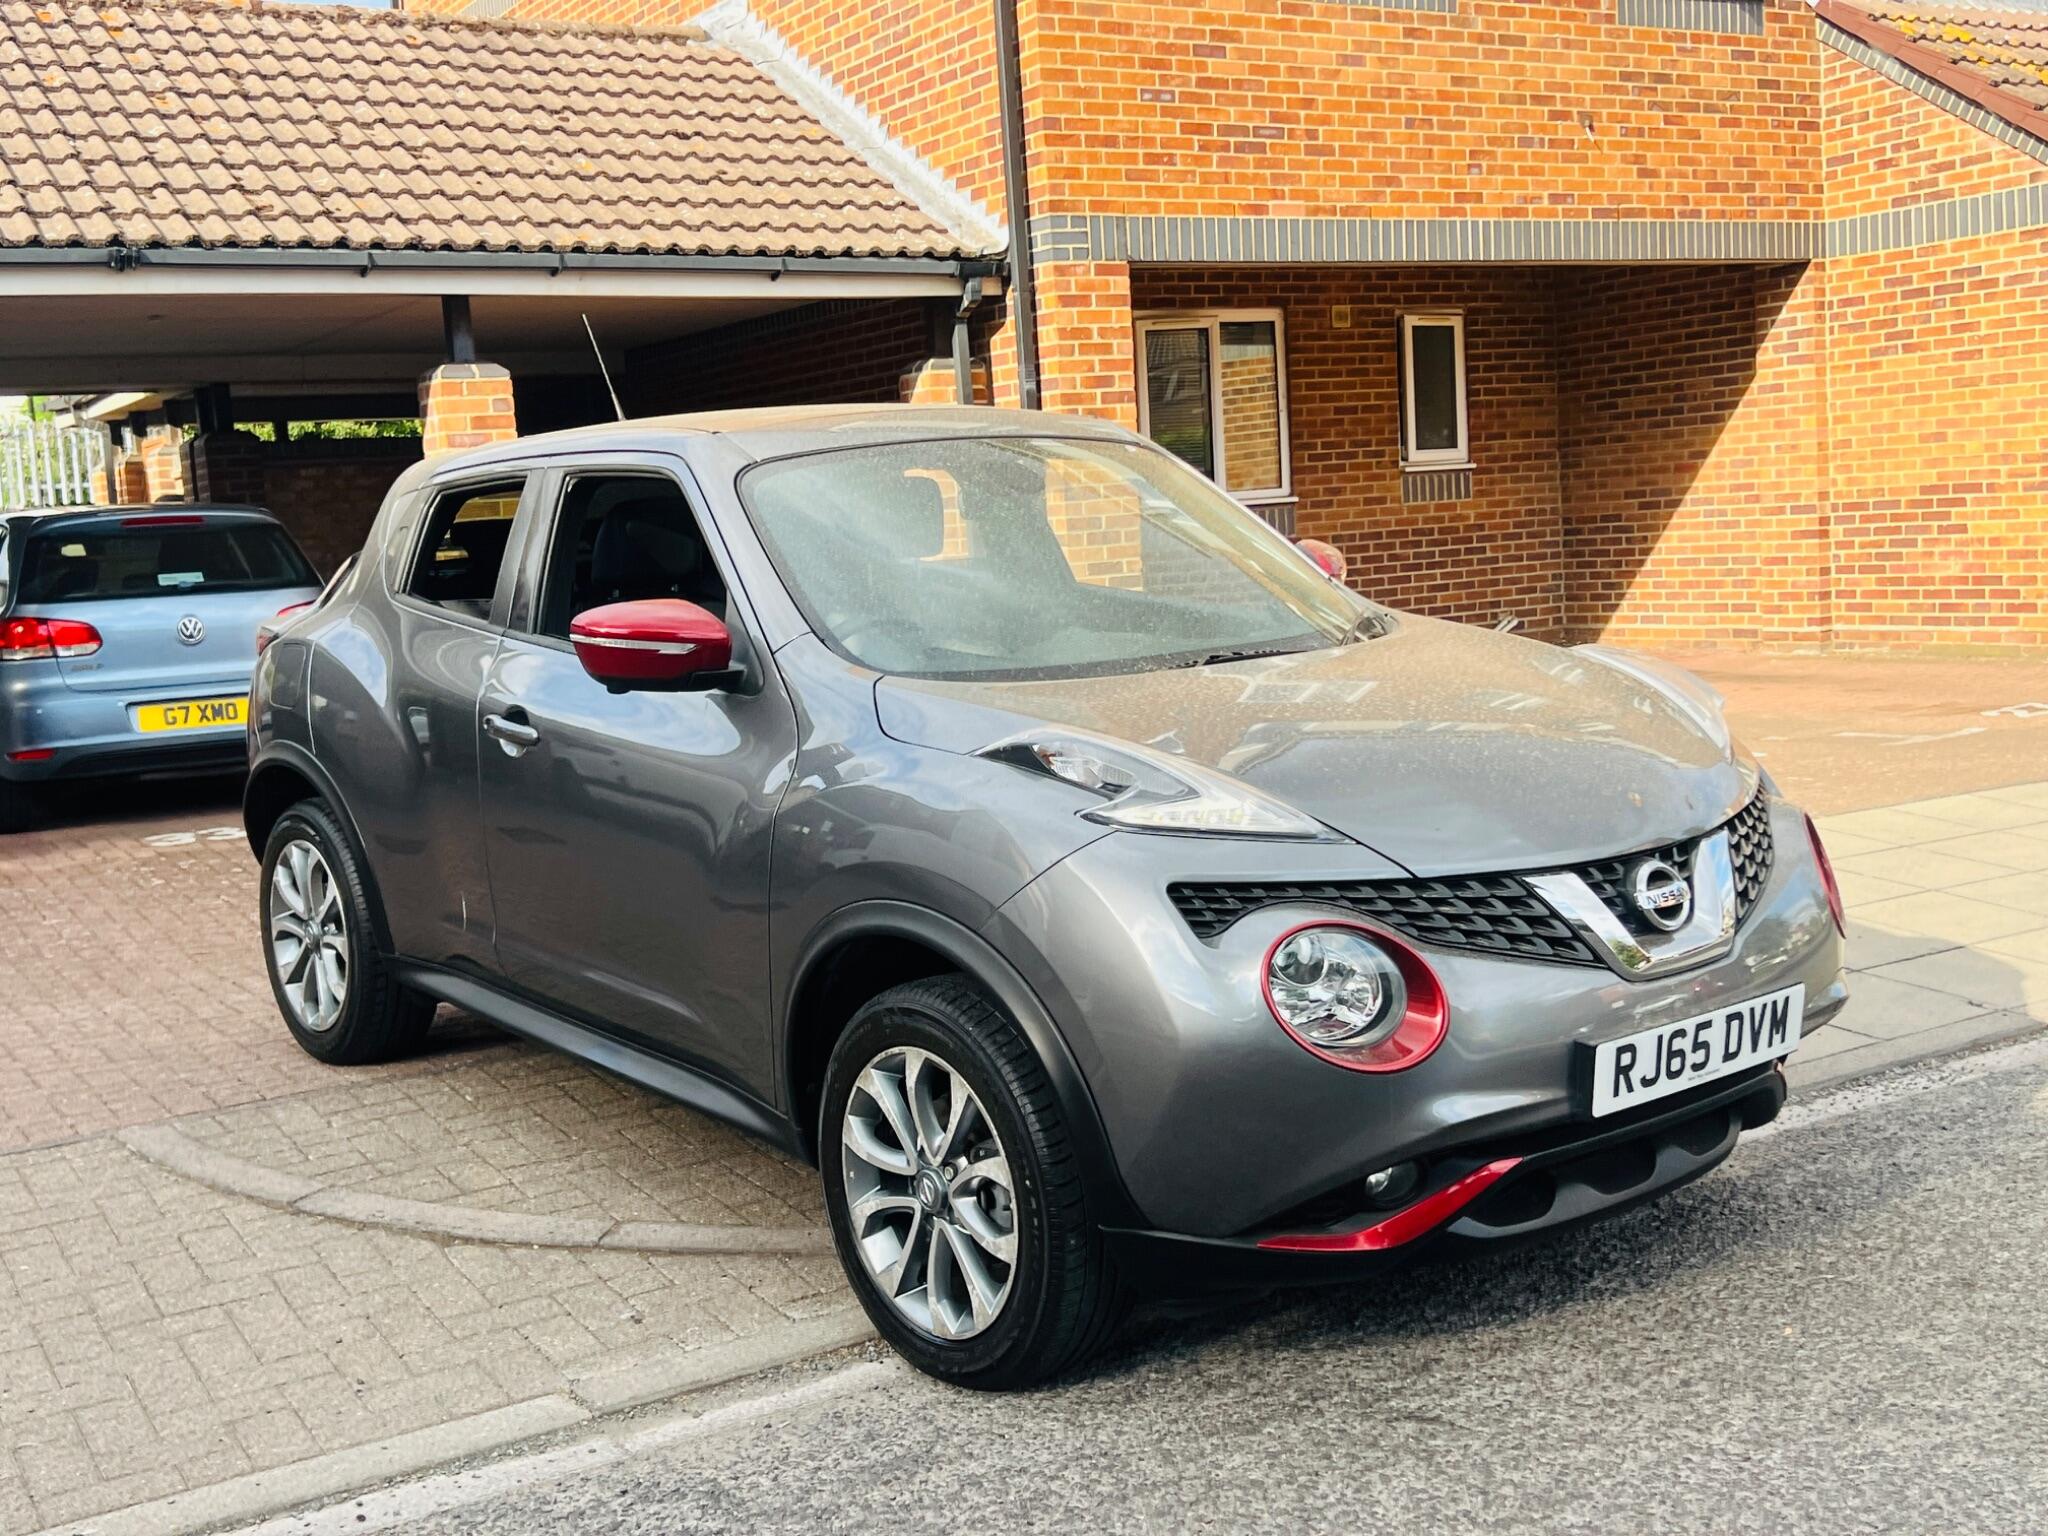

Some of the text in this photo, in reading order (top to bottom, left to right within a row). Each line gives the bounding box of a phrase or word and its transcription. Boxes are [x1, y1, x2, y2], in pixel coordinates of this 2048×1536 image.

[164, 706, 190, 726] G7
[1613, 996, 1789, 1097] RJ65 DVM
